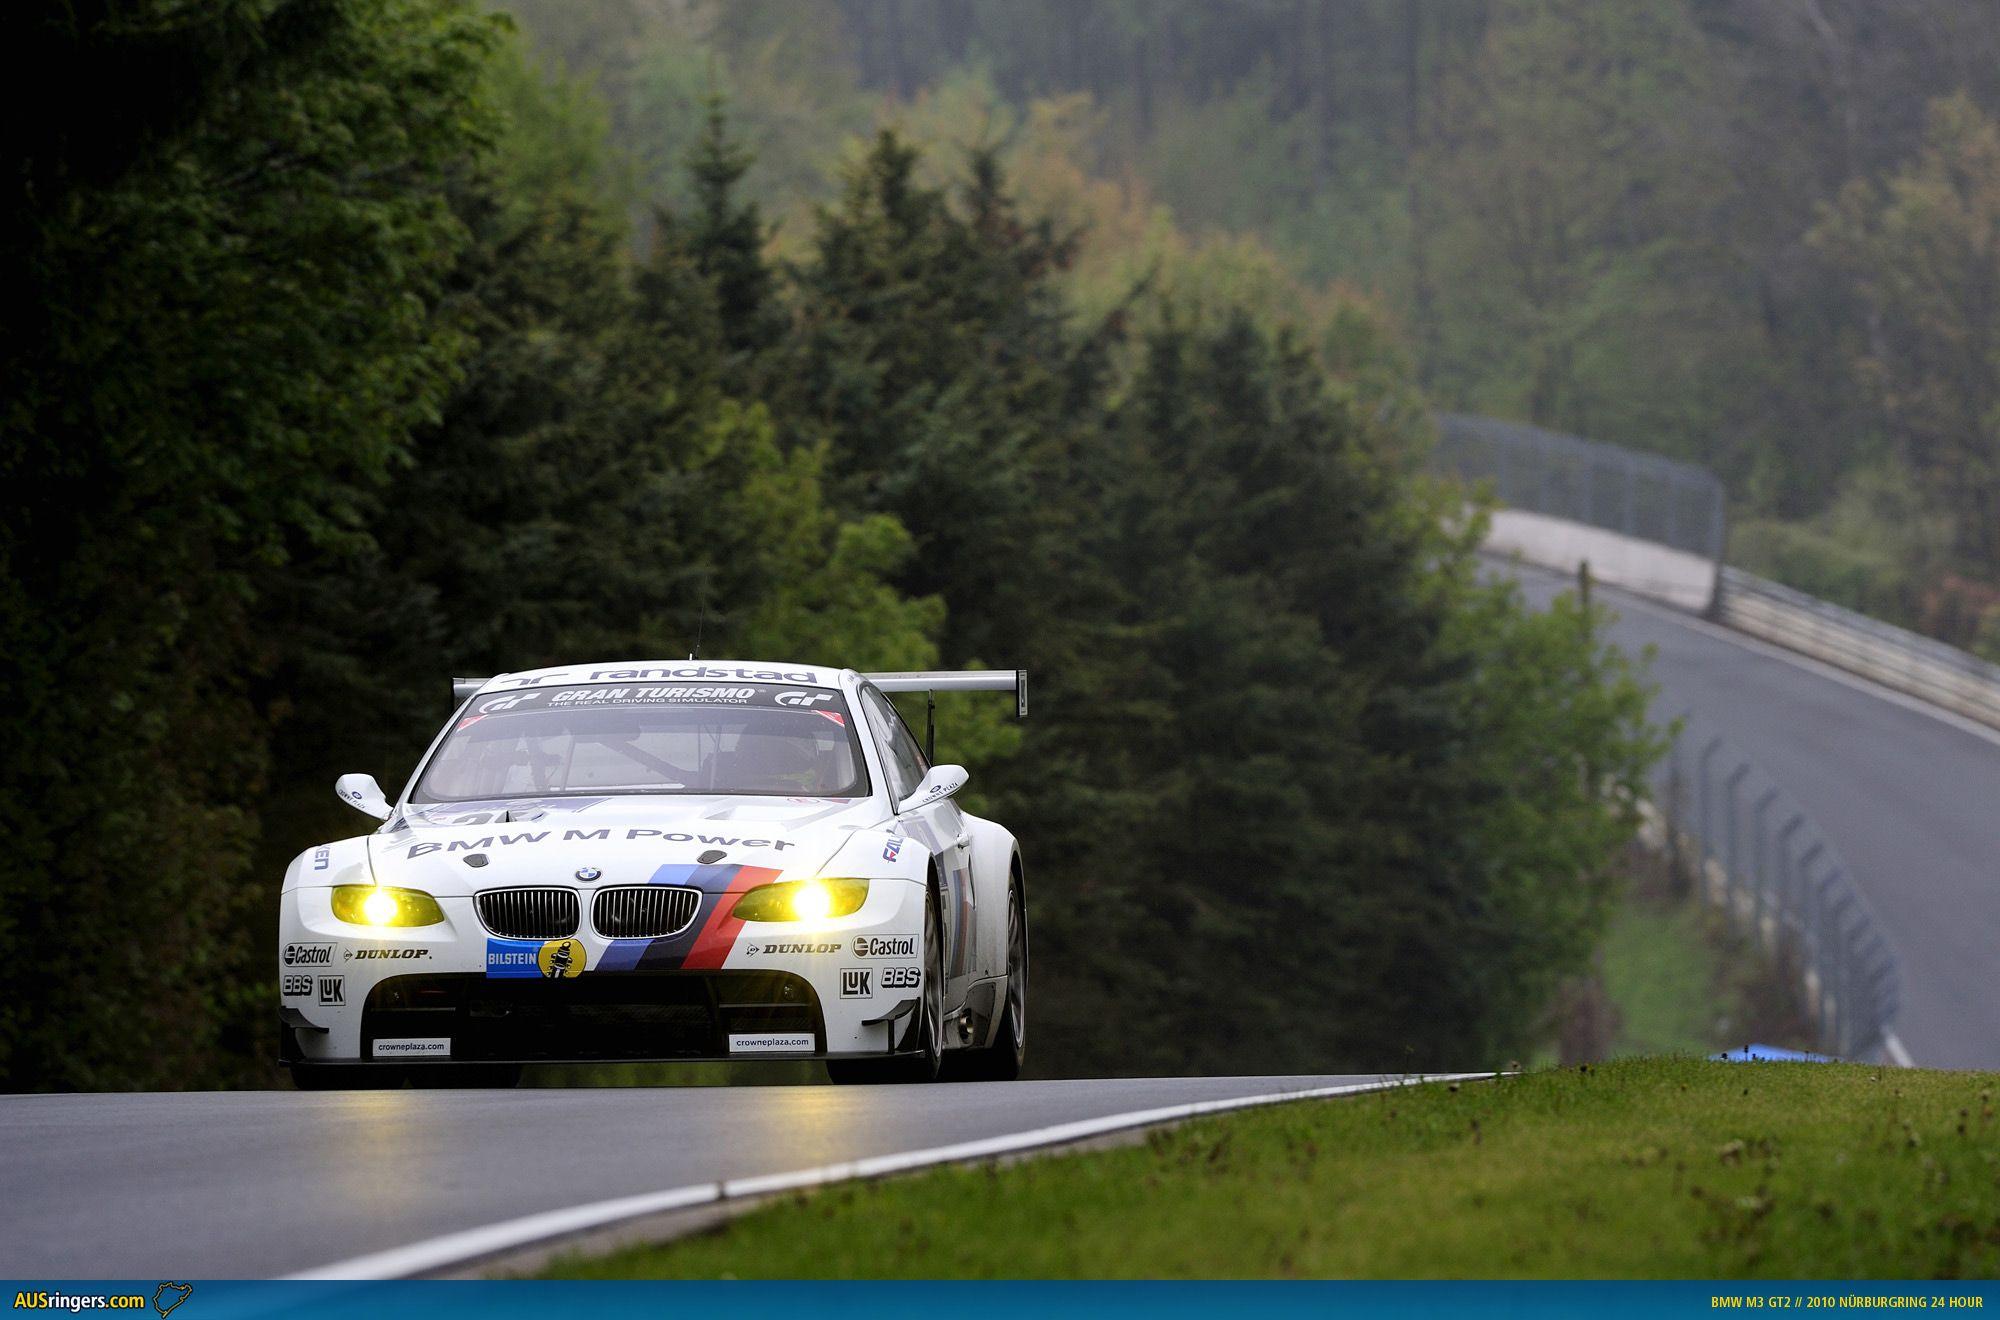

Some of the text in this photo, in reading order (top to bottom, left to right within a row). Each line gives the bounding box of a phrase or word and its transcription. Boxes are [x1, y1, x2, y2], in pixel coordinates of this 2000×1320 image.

[589, 667, 818, 684] randstad
[551, 687, 756, 702] GRAN TURISMO
[407, 829, 796, 859] BMW M Power
[355, 949, 429, 960] DUNLOP
[763, 943, 842, 954] DUNLOP
[869, 937, 914, 956] Castrol
[294, 946, 332, 964] Castrol
[488, 953, 537, 965] BILSTEIN
[283, 975, 313, 996] BBS
[881, 967, 921, 988] BBS
[378, 1042, 445, 1053] crowneplaza.com
[736, 1036, 809, 1049] crowneplaza.com
